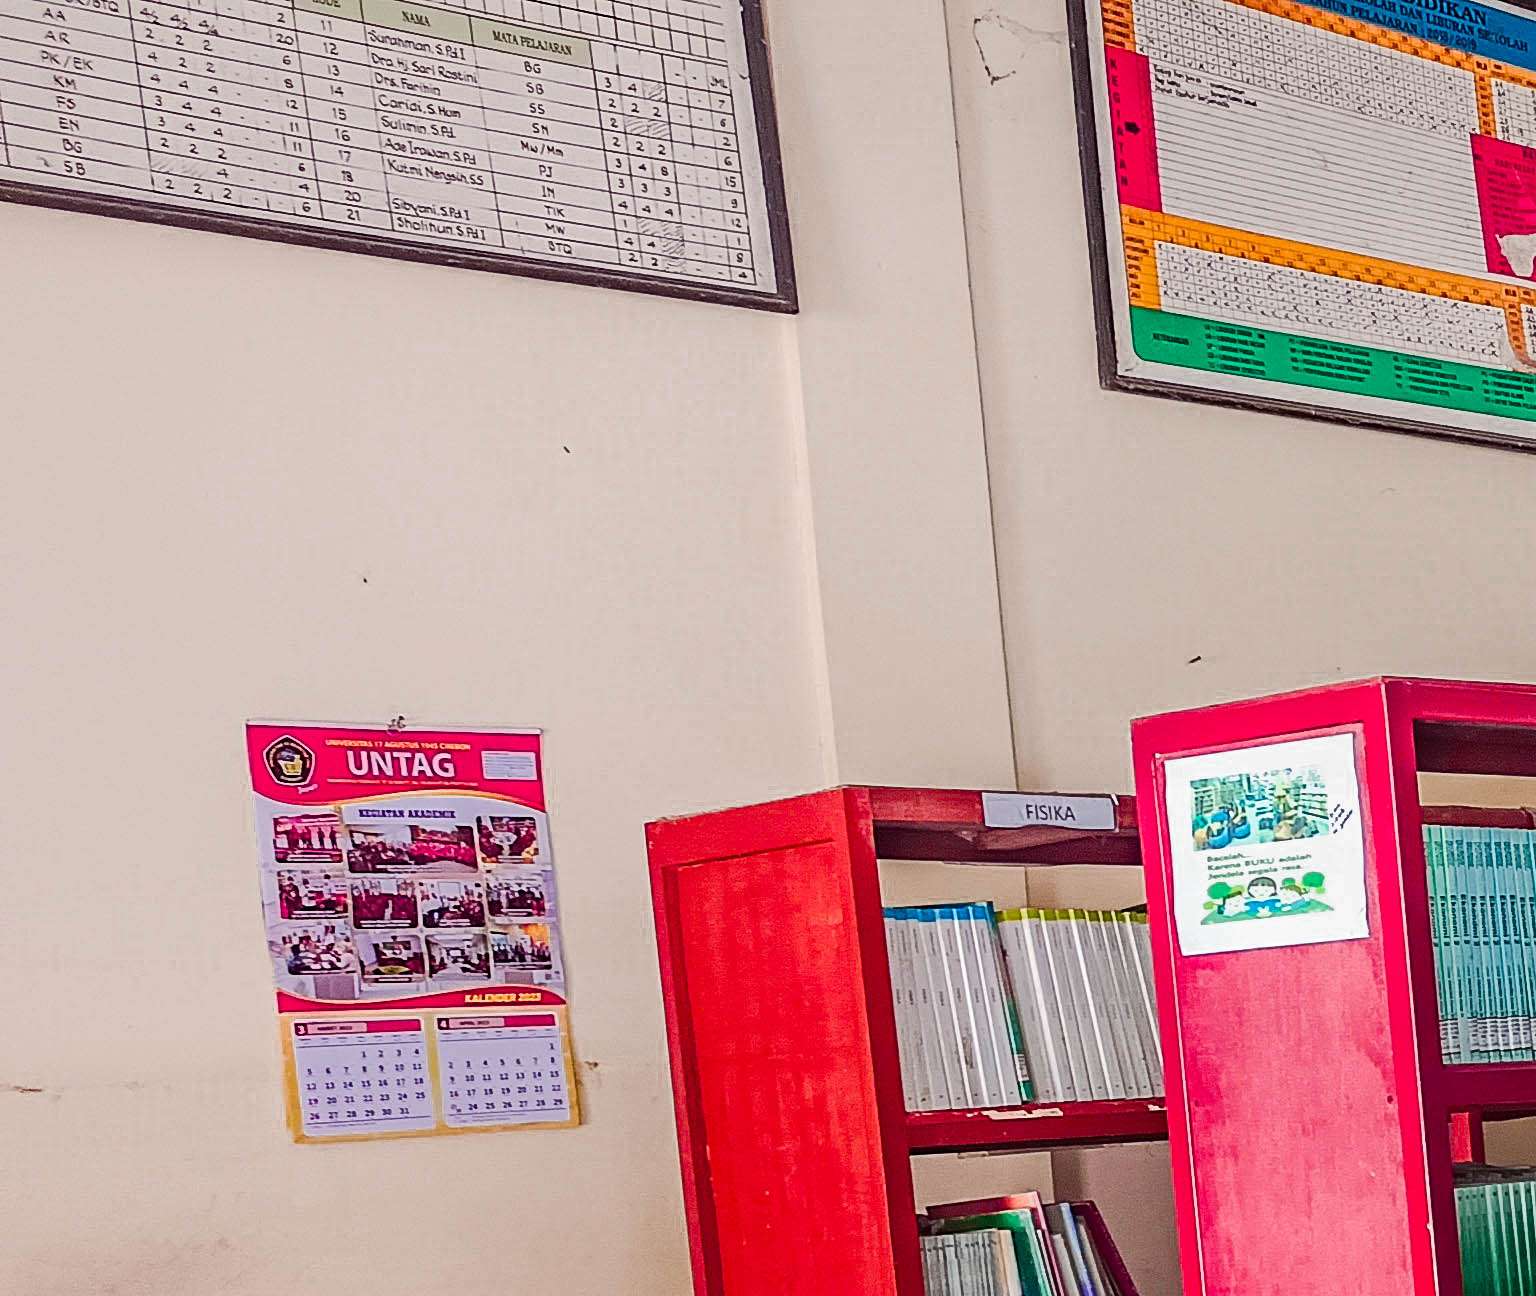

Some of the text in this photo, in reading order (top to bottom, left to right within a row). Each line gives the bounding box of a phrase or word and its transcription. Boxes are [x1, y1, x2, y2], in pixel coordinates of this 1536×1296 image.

[401, 10, 430, 27] NAMA
[44, 29, 71, 45] AR
[492, 30, 573, 57] MATA PELAJARAN
[323, 42, 338, 56] 12
[327, 64, 340, 77] 13
[524, 61, 542, 74] BG
[53, 74, 78, 90] KM
[330, 85, 344, 97] 14
[527, 83, 545, 95] SB
[56, 96, 77, 110] FS
[530, 103, 545, 115] SS
[332, 107, 347, 120] 15
[58, 117, 80, 131] EN
[335, 128, 351, 142] 16
[62, 138, 82, 154] BG
[338, 150, 351, 163] 17
[64, 161, 87, 176] SB
[538, 165, 553, 178] PJ
[343, 190, 362, 203] 20
[347, 209, 361, 222] 21
[544, 205, 565, 218] TIK
[349, 750, 456, 778] UNTAG
[408, 809, 456, 819] AKADEMIK
[1025, 804, 1076, 822] FISIKA
[1207, 853, 1312, 872] Karena BUKU adalah
[465, 993, 516, 1003] KALENDER
